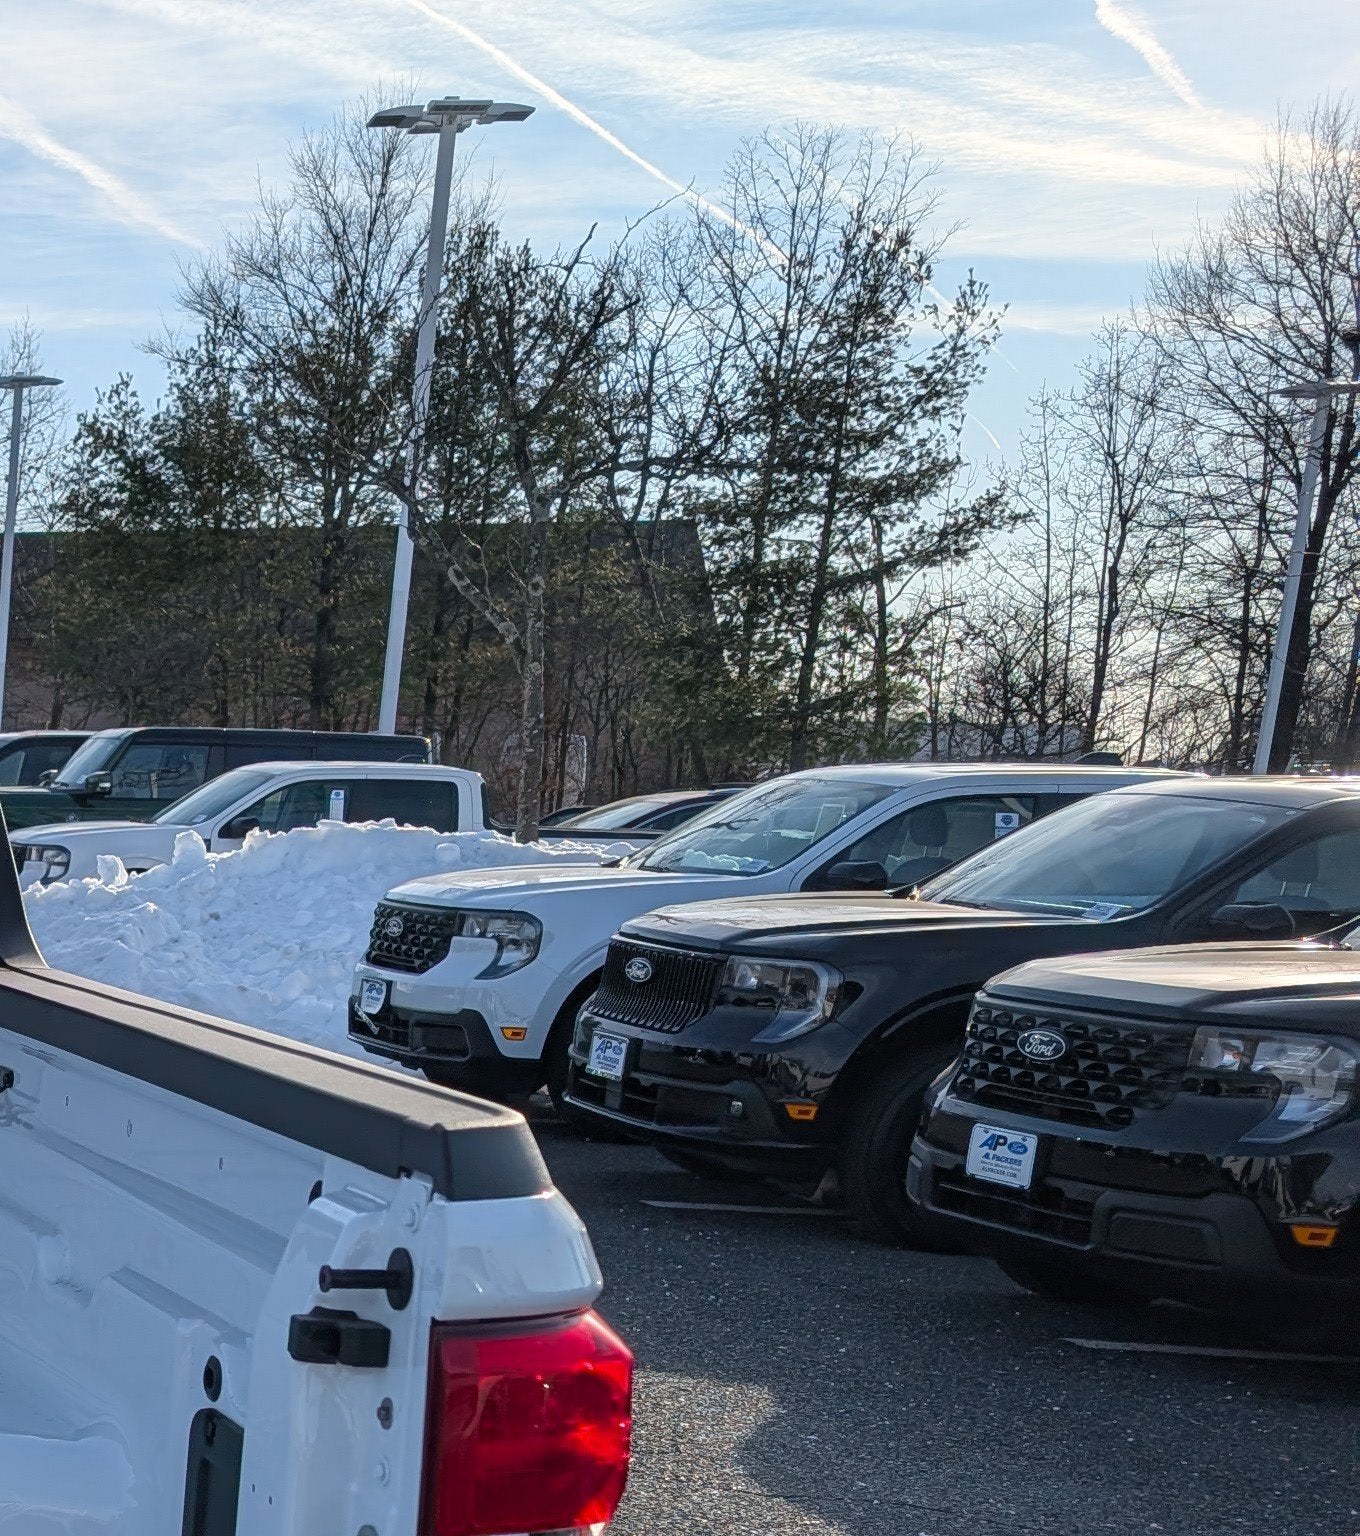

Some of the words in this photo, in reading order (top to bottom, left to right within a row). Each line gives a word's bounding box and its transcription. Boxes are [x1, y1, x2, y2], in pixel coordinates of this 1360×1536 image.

[595, 1040, 613, 1054] AP
[1025, 1034, 1056, 1056] Ford
[979, 1133, 1008, 1151] AP
